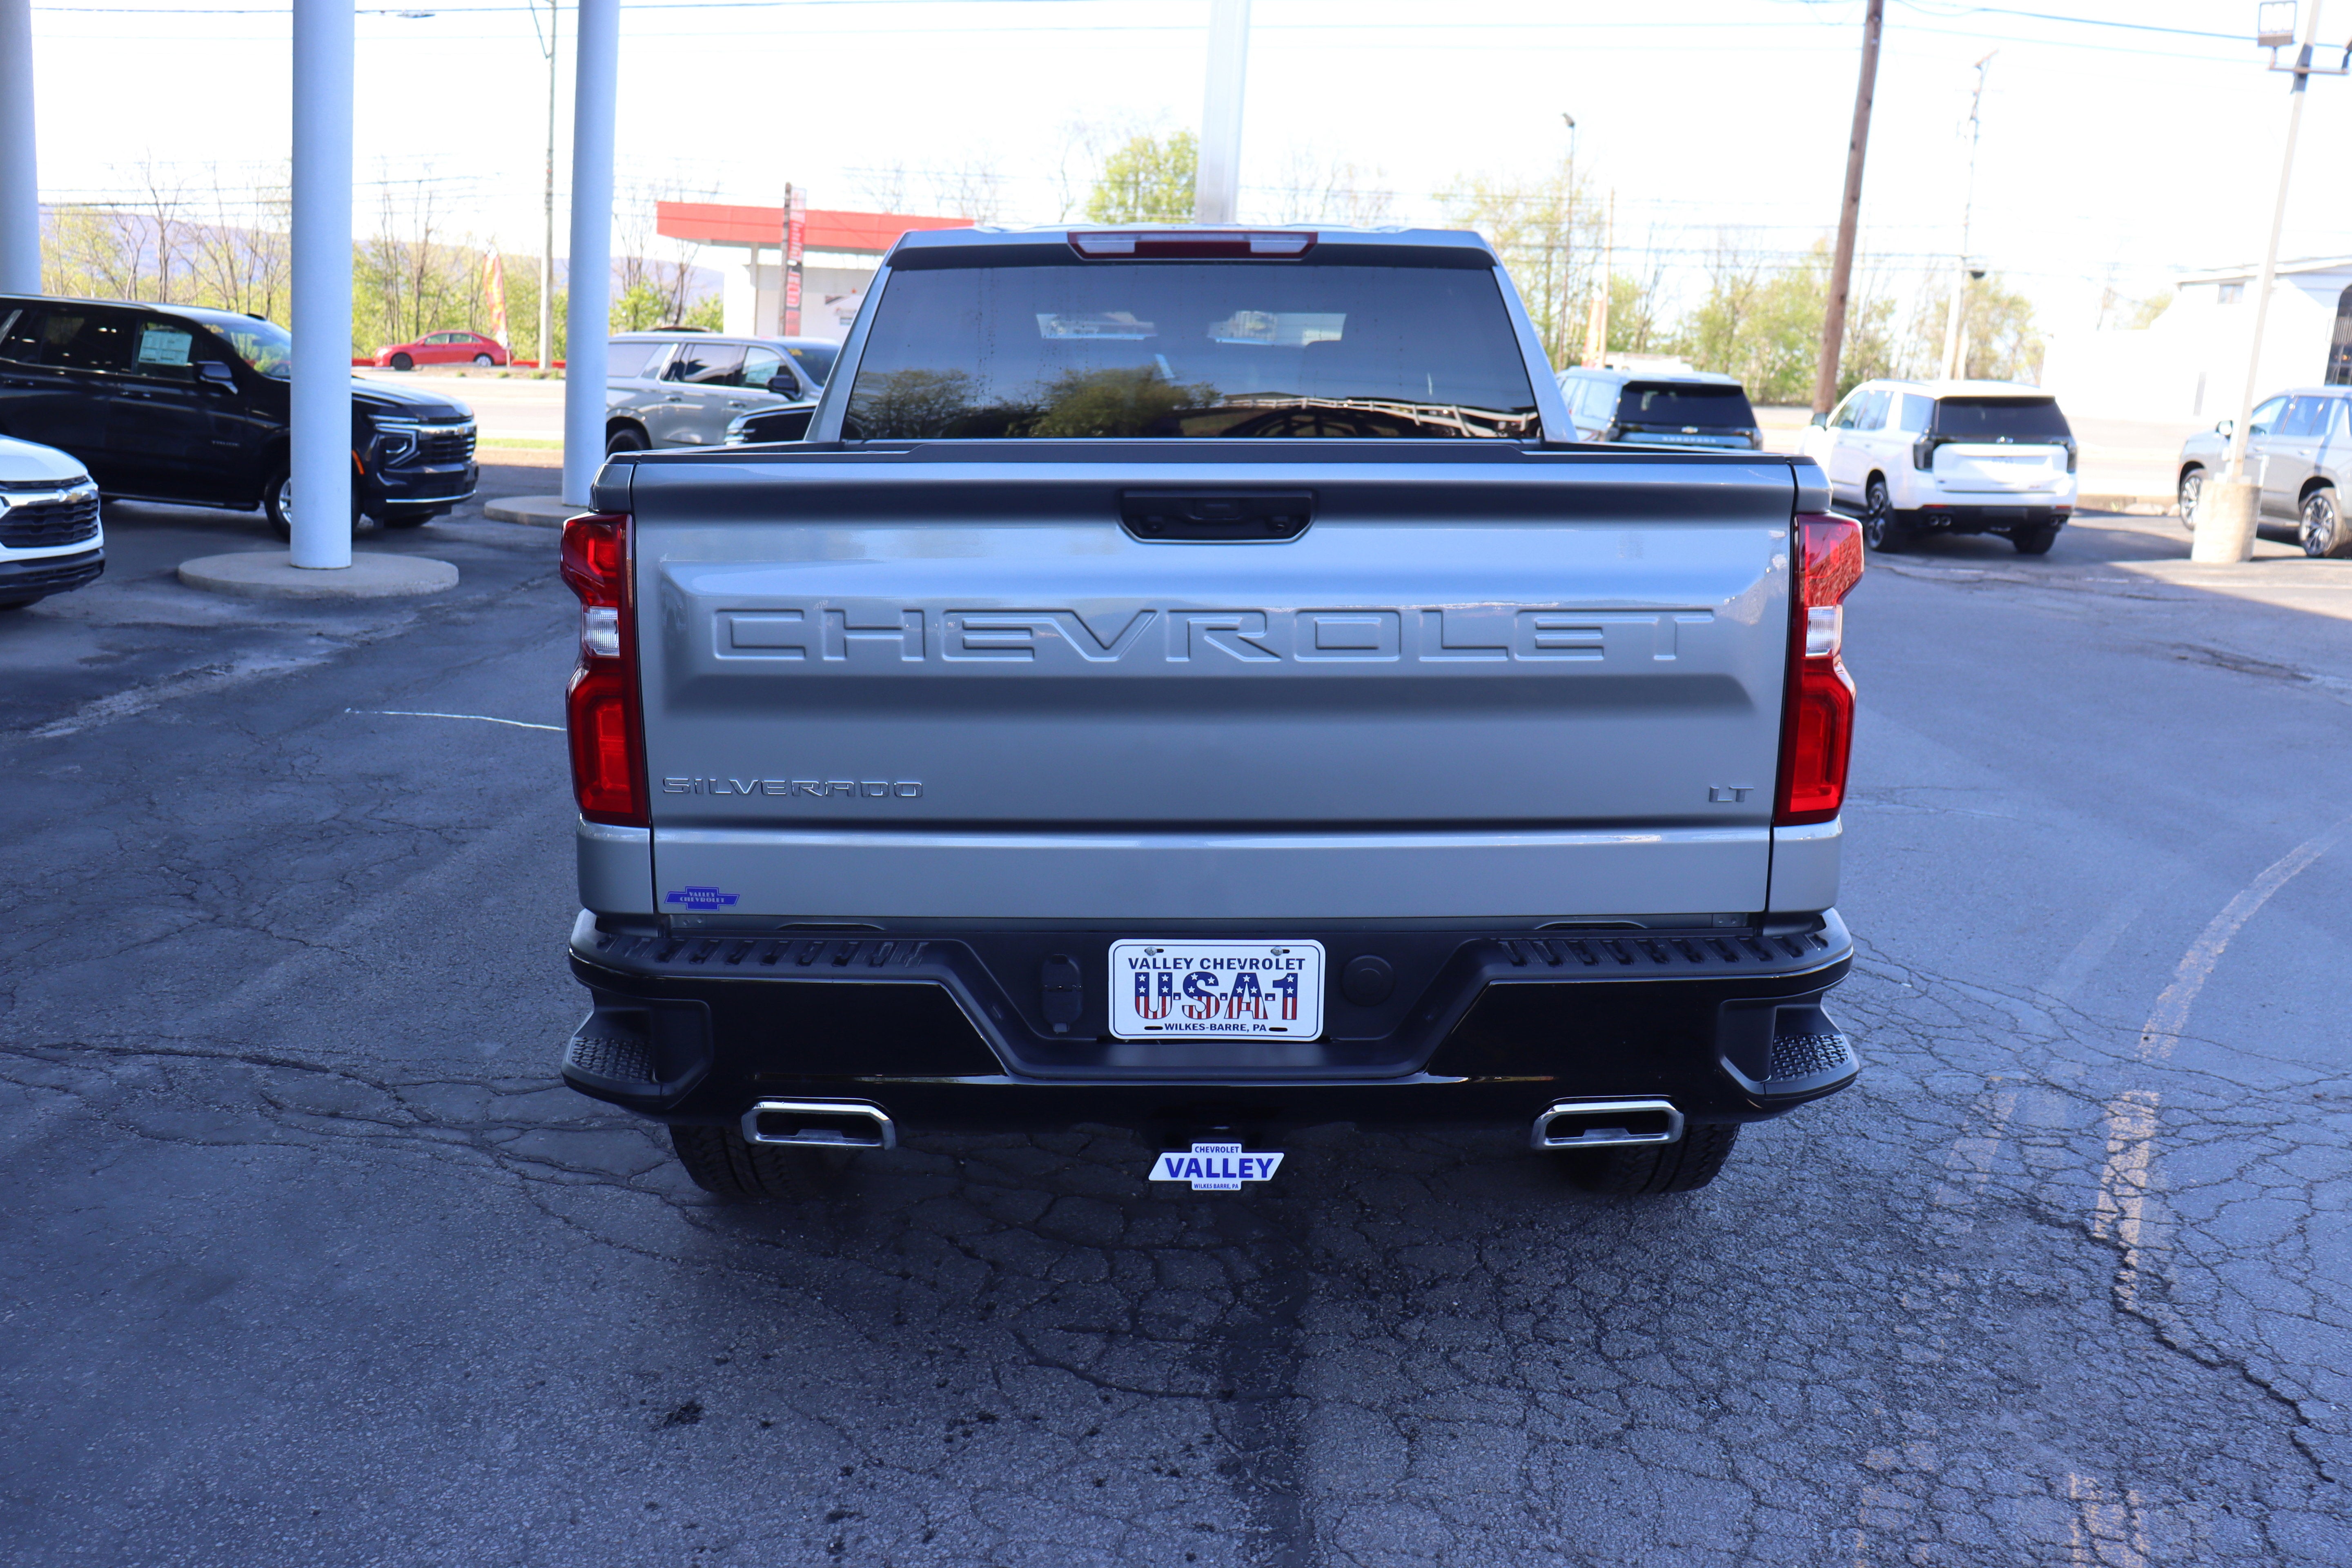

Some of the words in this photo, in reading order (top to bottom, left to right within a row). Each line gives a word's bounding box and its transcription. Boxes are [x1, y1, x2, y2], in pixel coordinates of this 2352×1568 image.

[713, 608, 1714, 662] CHEVROLET
[663, 777, 924, 798] SILVERADO
[1708, 786, 1754, 802] LT
[1128, 958, 1194, 970] VALLEY
[1199, 958, 1305, 970] CHEVROLET
[1164, 1023, 1250, 1033] WILKES-BARRE,
[1253, 1024, 1267, 1032] PA
[1164, 1158, 1274, 1178] VALLEY
